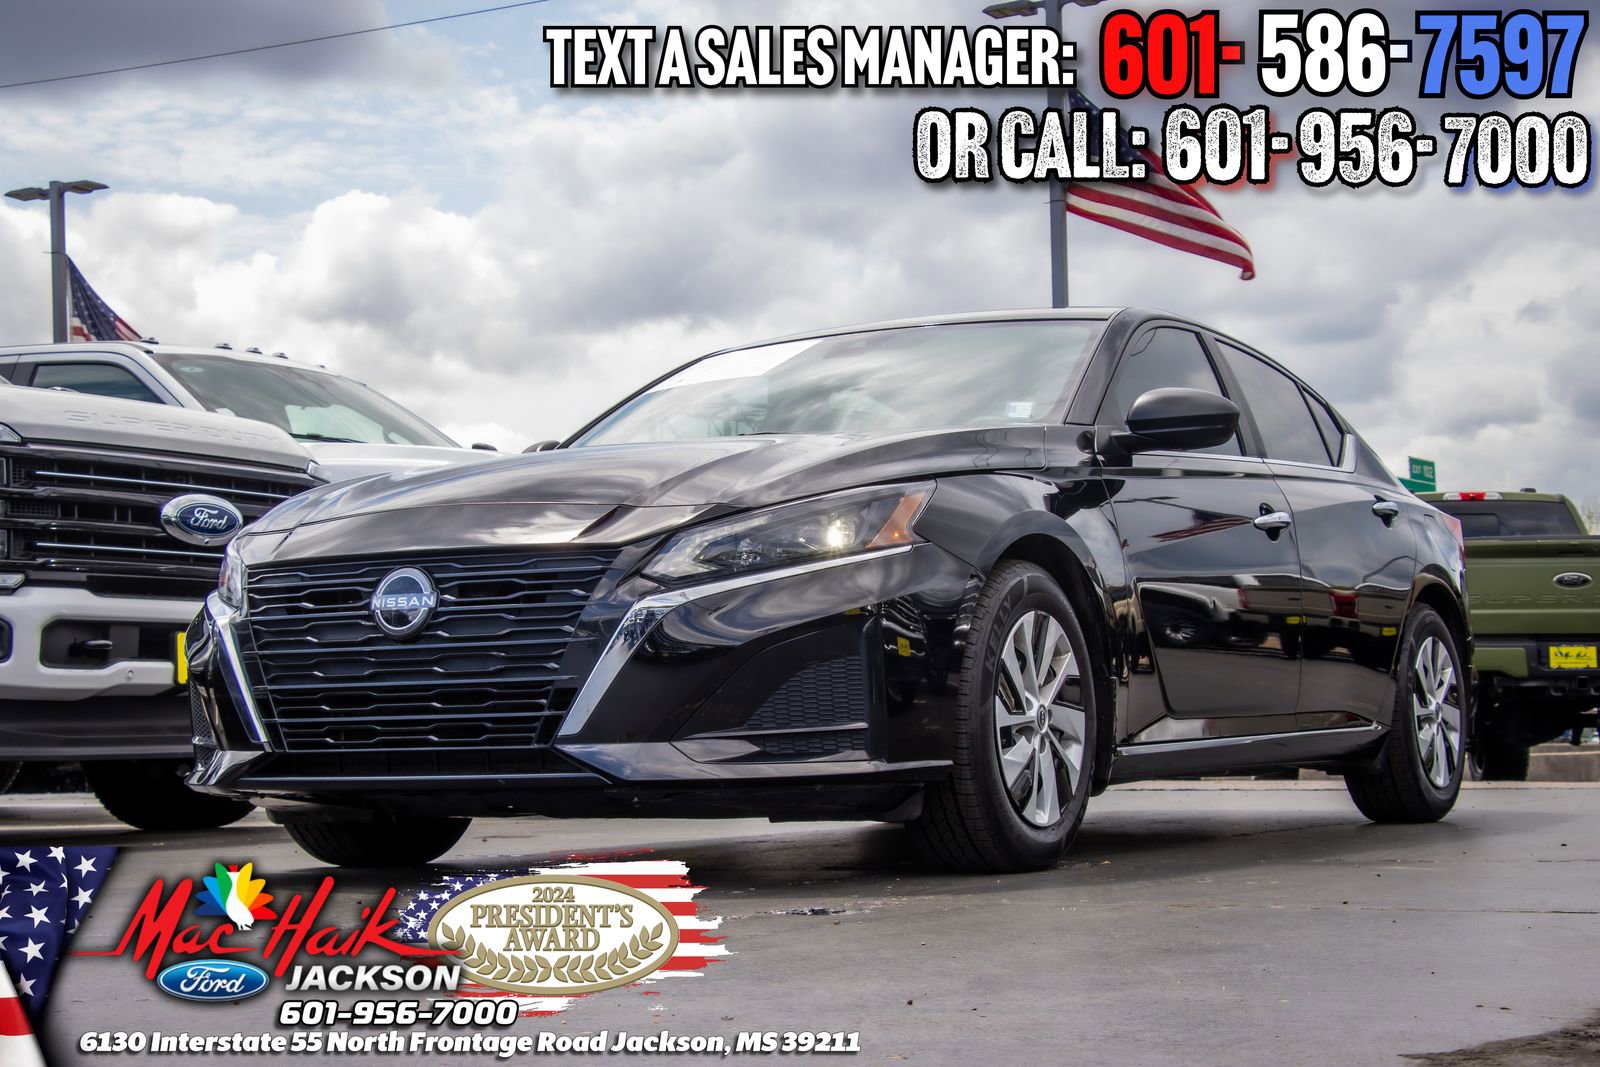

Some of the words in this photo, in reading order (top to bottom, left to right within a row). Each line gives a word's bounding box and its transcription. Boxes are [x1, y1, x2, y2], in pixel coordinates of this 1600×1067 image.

[190, 507, 229, 531] Ford
[371, 595, 434, 609] NISSAN
[984, 594, 1012, 674] KELLY
